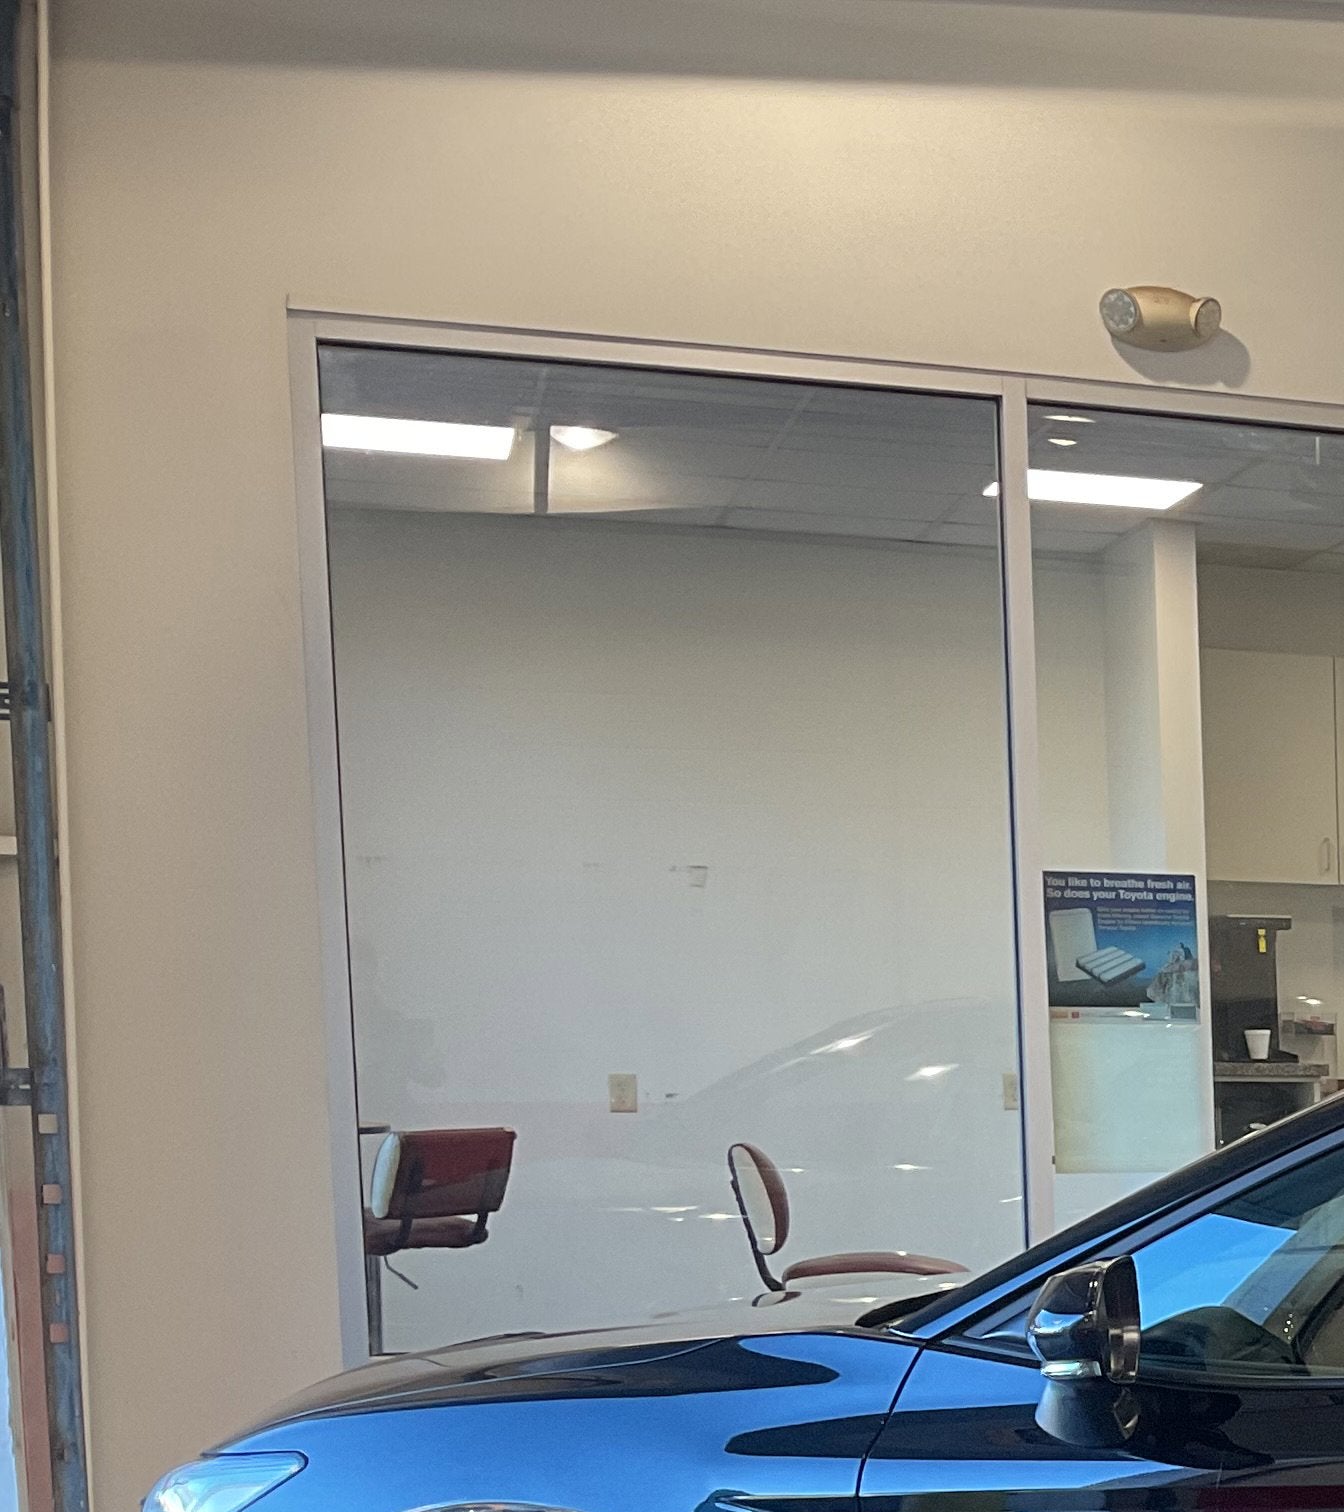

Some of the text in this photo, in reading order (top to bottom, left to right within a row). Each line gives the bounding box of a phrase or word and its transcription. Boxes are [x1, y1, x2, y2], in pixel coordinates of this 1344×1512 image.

[1045, 876, 1193, 890] You like to breathe fresh air.
[1046, 888, 1194, 903] So does your Toyota engine.
